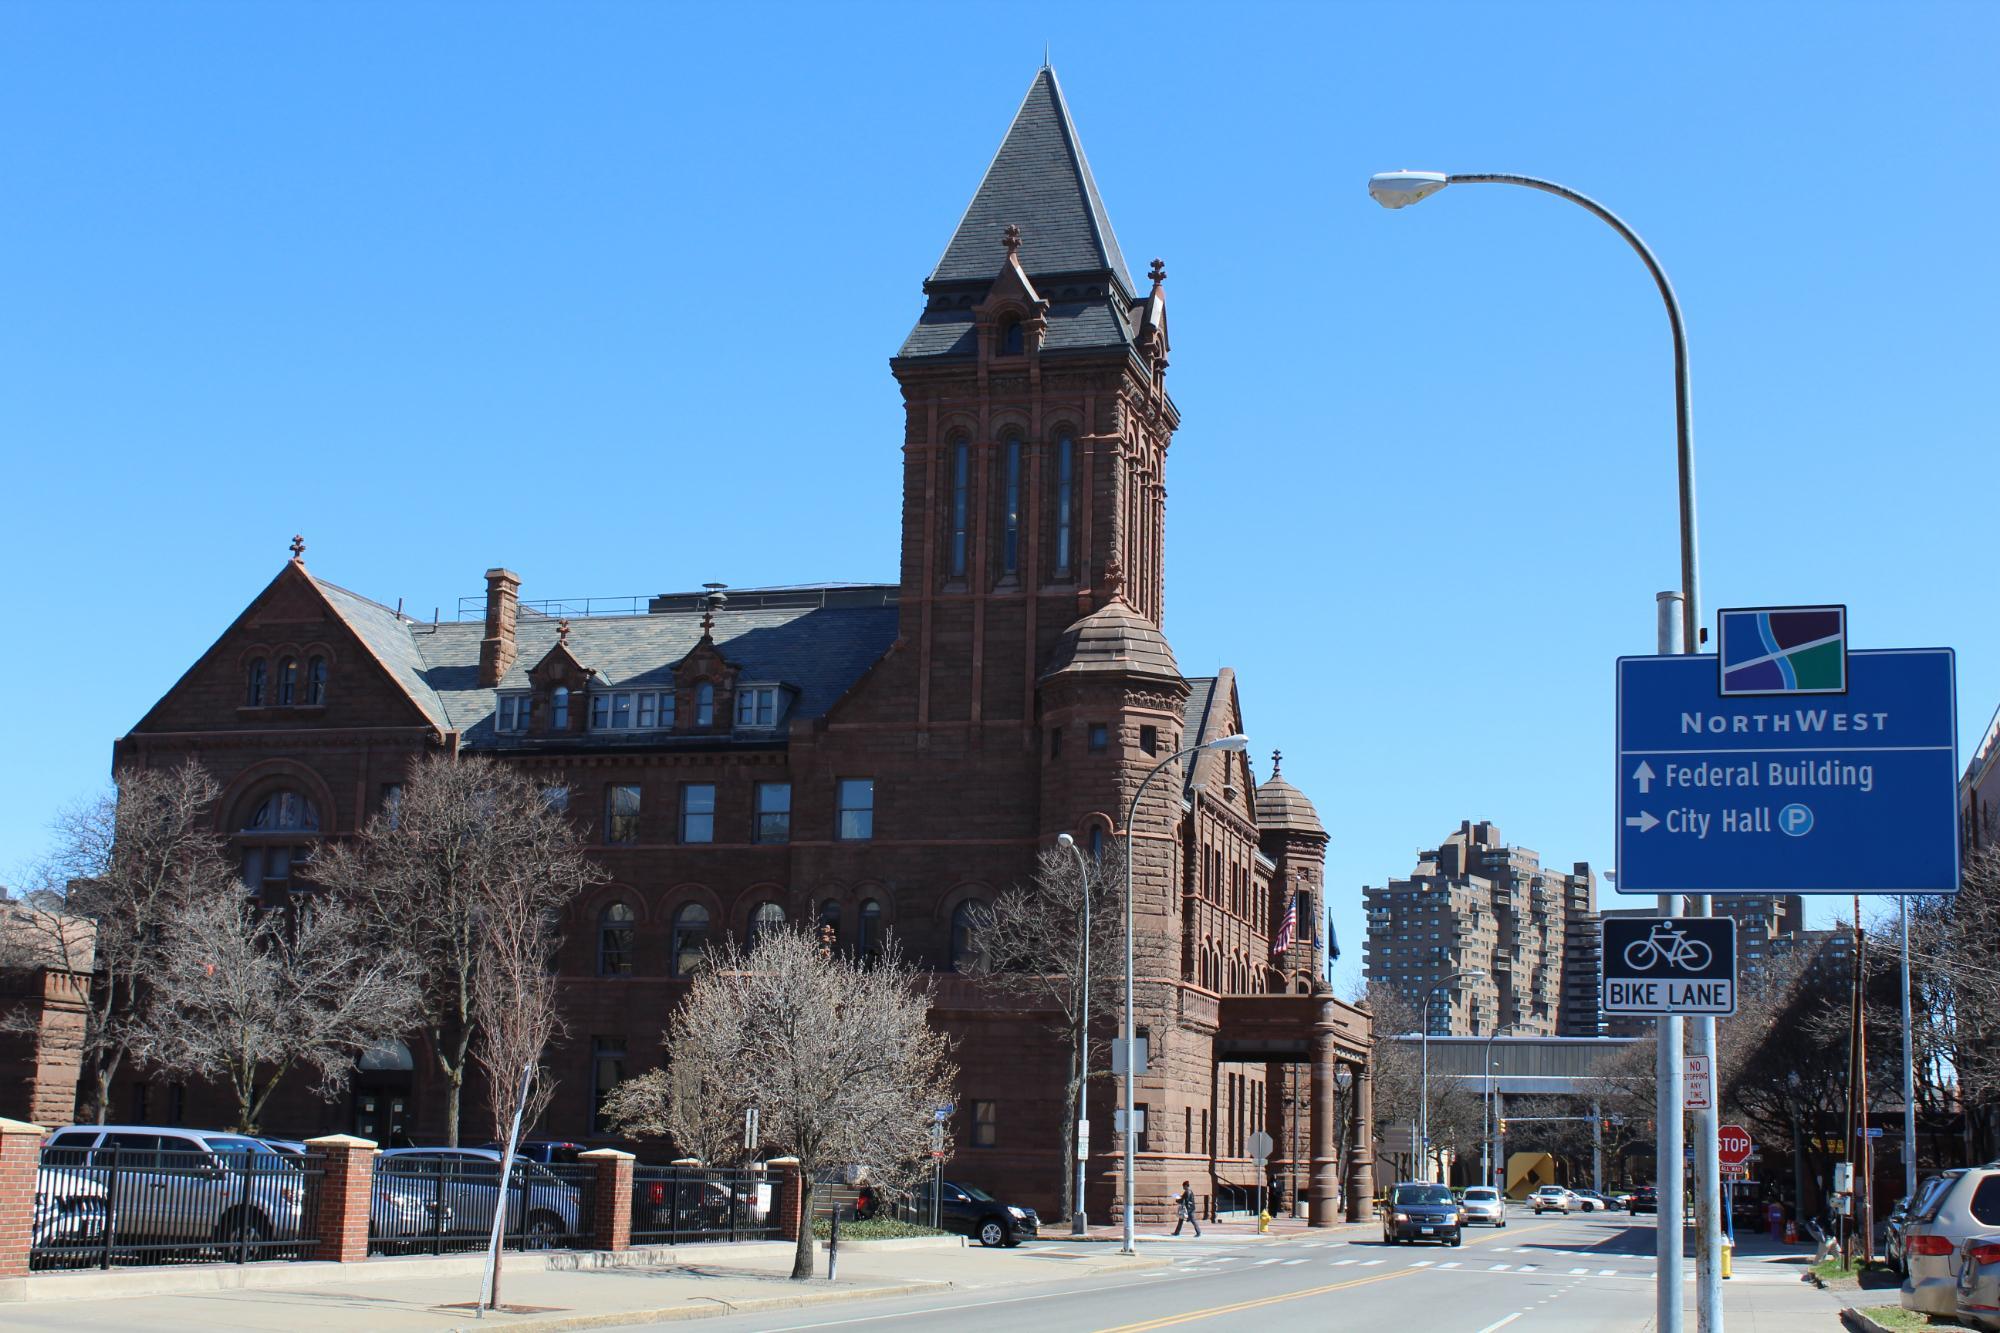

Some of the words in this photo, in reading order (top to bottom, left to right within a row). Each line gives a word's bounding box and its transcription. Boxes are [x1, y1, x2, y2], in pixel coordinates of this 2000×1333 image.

[1666, 761, 1760, 788] Federal
[1768, 760, 1874, 792] Building
[1666, 807, 1711, 839] City
[1722, 807, 1771, 833] Hall
[1788, 809, 1806, 831] P
[1610, 983, 1658, 1005] BIKE
[1668, 983, 1726, 1006] LANE
[1689, 1061, 1701, 1071] NO
